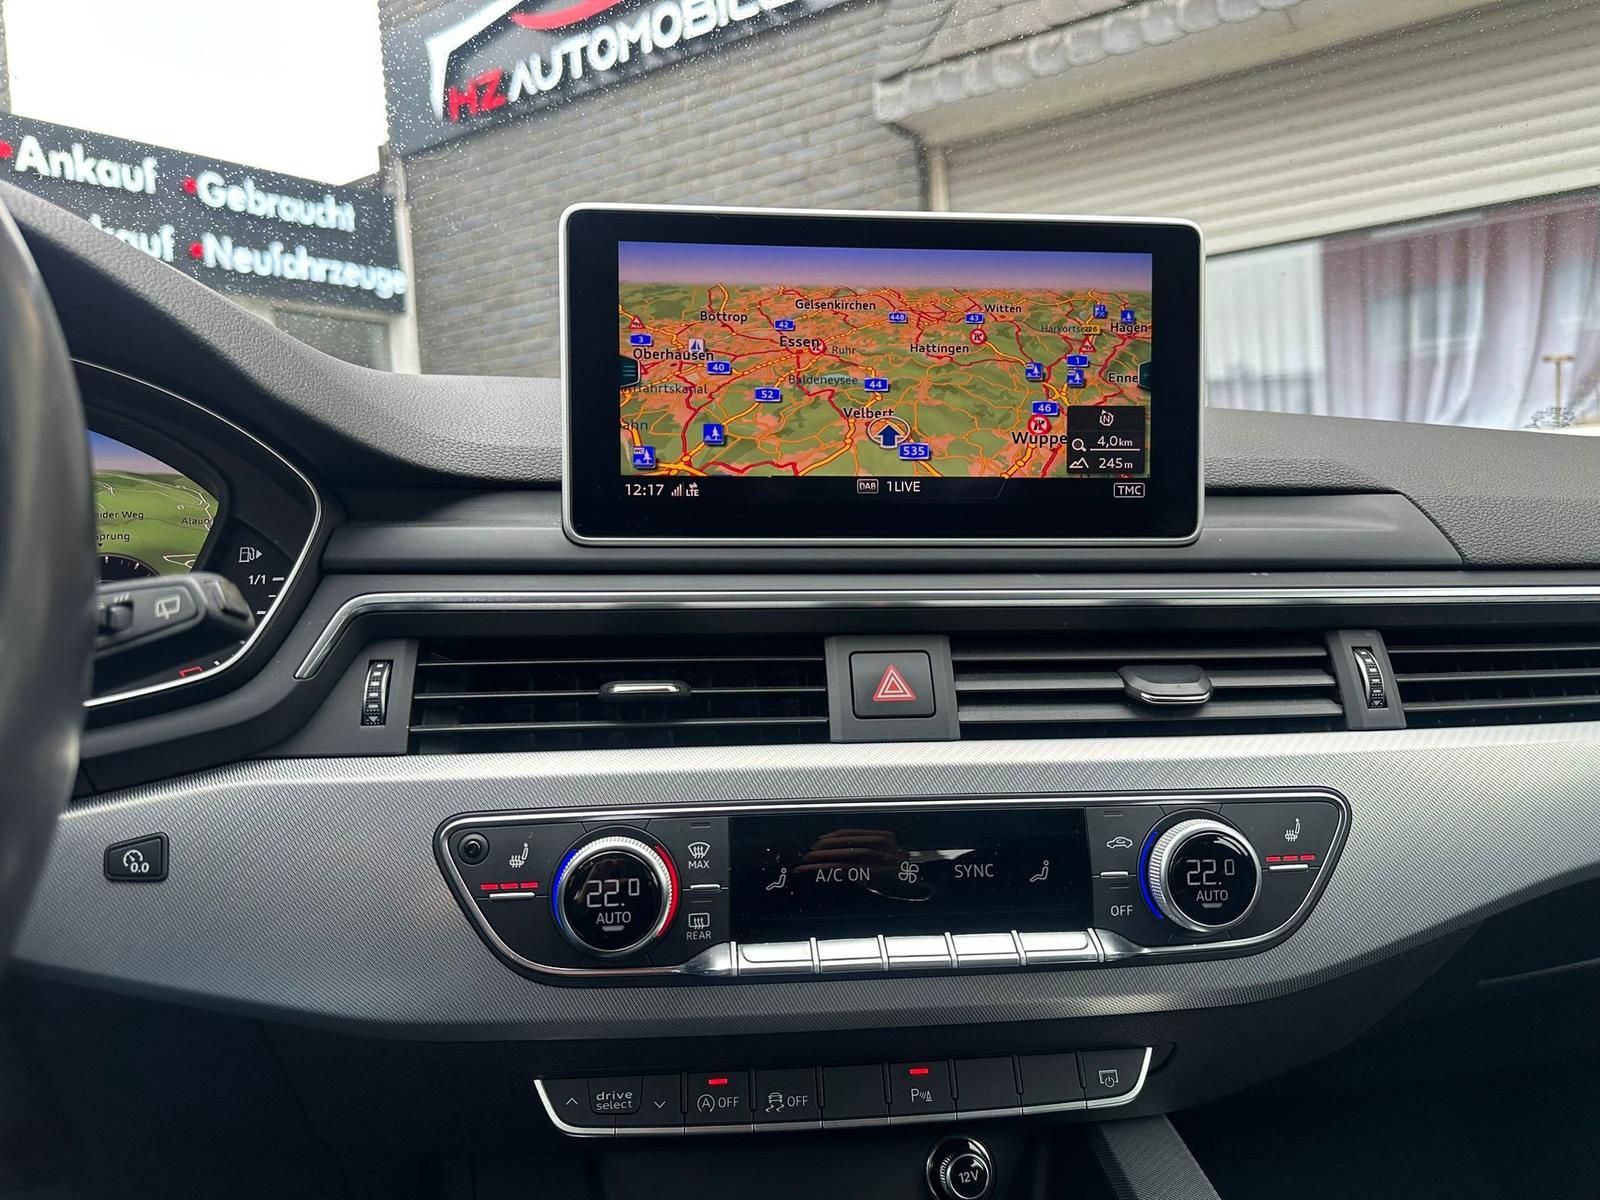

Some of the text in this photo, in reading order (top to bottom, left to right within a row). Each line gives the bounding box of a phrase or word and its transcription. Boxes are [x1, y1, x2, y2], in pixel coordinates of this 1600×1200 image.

[447, 0, 797, 122] HZ AUTOMOBIL
[15, 135, 158, 195] Ankauf
[197, 170, 356, 232] Gebraucht
[202, 231, 408, 299] Neufahrzeuge
[795, 299, 876, 311] Gelsenkirchen
[984, 303, 1022, 314] Witten
[700, 310, 748, 324] Bottrop
[969, 314, 979, 322] 43
[778, 320, 789, 329] 42
[1110, 322, 1148, 335] Hagen
[638, 335, 644, 344] 3
[779, 335, 820, 348] Essen
[633, 348, 714, 361] Oberhausen
[832, 345, 856, 355] Ruhr
[909, 343, 969, 356] Hattingen
[712, 364, 725, 373] 40
[788, 374, 858, 386] Baldeneysee
[1108, 372, 1138, 383] Enne
[869, 380, 882, 389] 44
[761, 389, 774, 399] 52
[843, 407, 894, 419] Velbert
[1038, 403, 1052, 413] 46
[1011, 431, 1067, 448] Wuppe
[903, 446, 925, 456] 535
[625, 483, 664, 496] 12:17
[859, 482, 877, 490] DAB
[1117, 485, 1142, 496] TMC
[685, 489, 699, 497] LTE
[121, 511, 144, 520] Weg
[248, 575, 266, 585] 1/1
[130, 862, 150, 873] 0.0
[688, 861, 710, 869] MAX
[815, 867, 870, 882] A/C ON
[954, 864, 994, 878] SYNC
[1196, 890, 1229, 901] AUTO
[1110, 905, 1133, 916] OFF
[595, 911, 632, 924] AUTO
[686, 931, 712, 940] REAR
[596, 1090, 633, 1100] drive
[911, 1088, 919, 1102] P
[596, 1100, 633, 1111] select
[718, 1097, 739, 1108] OFF
[787, 1096, 808, 1107] OFF
[958, 1170, 979, 1183] 12V
